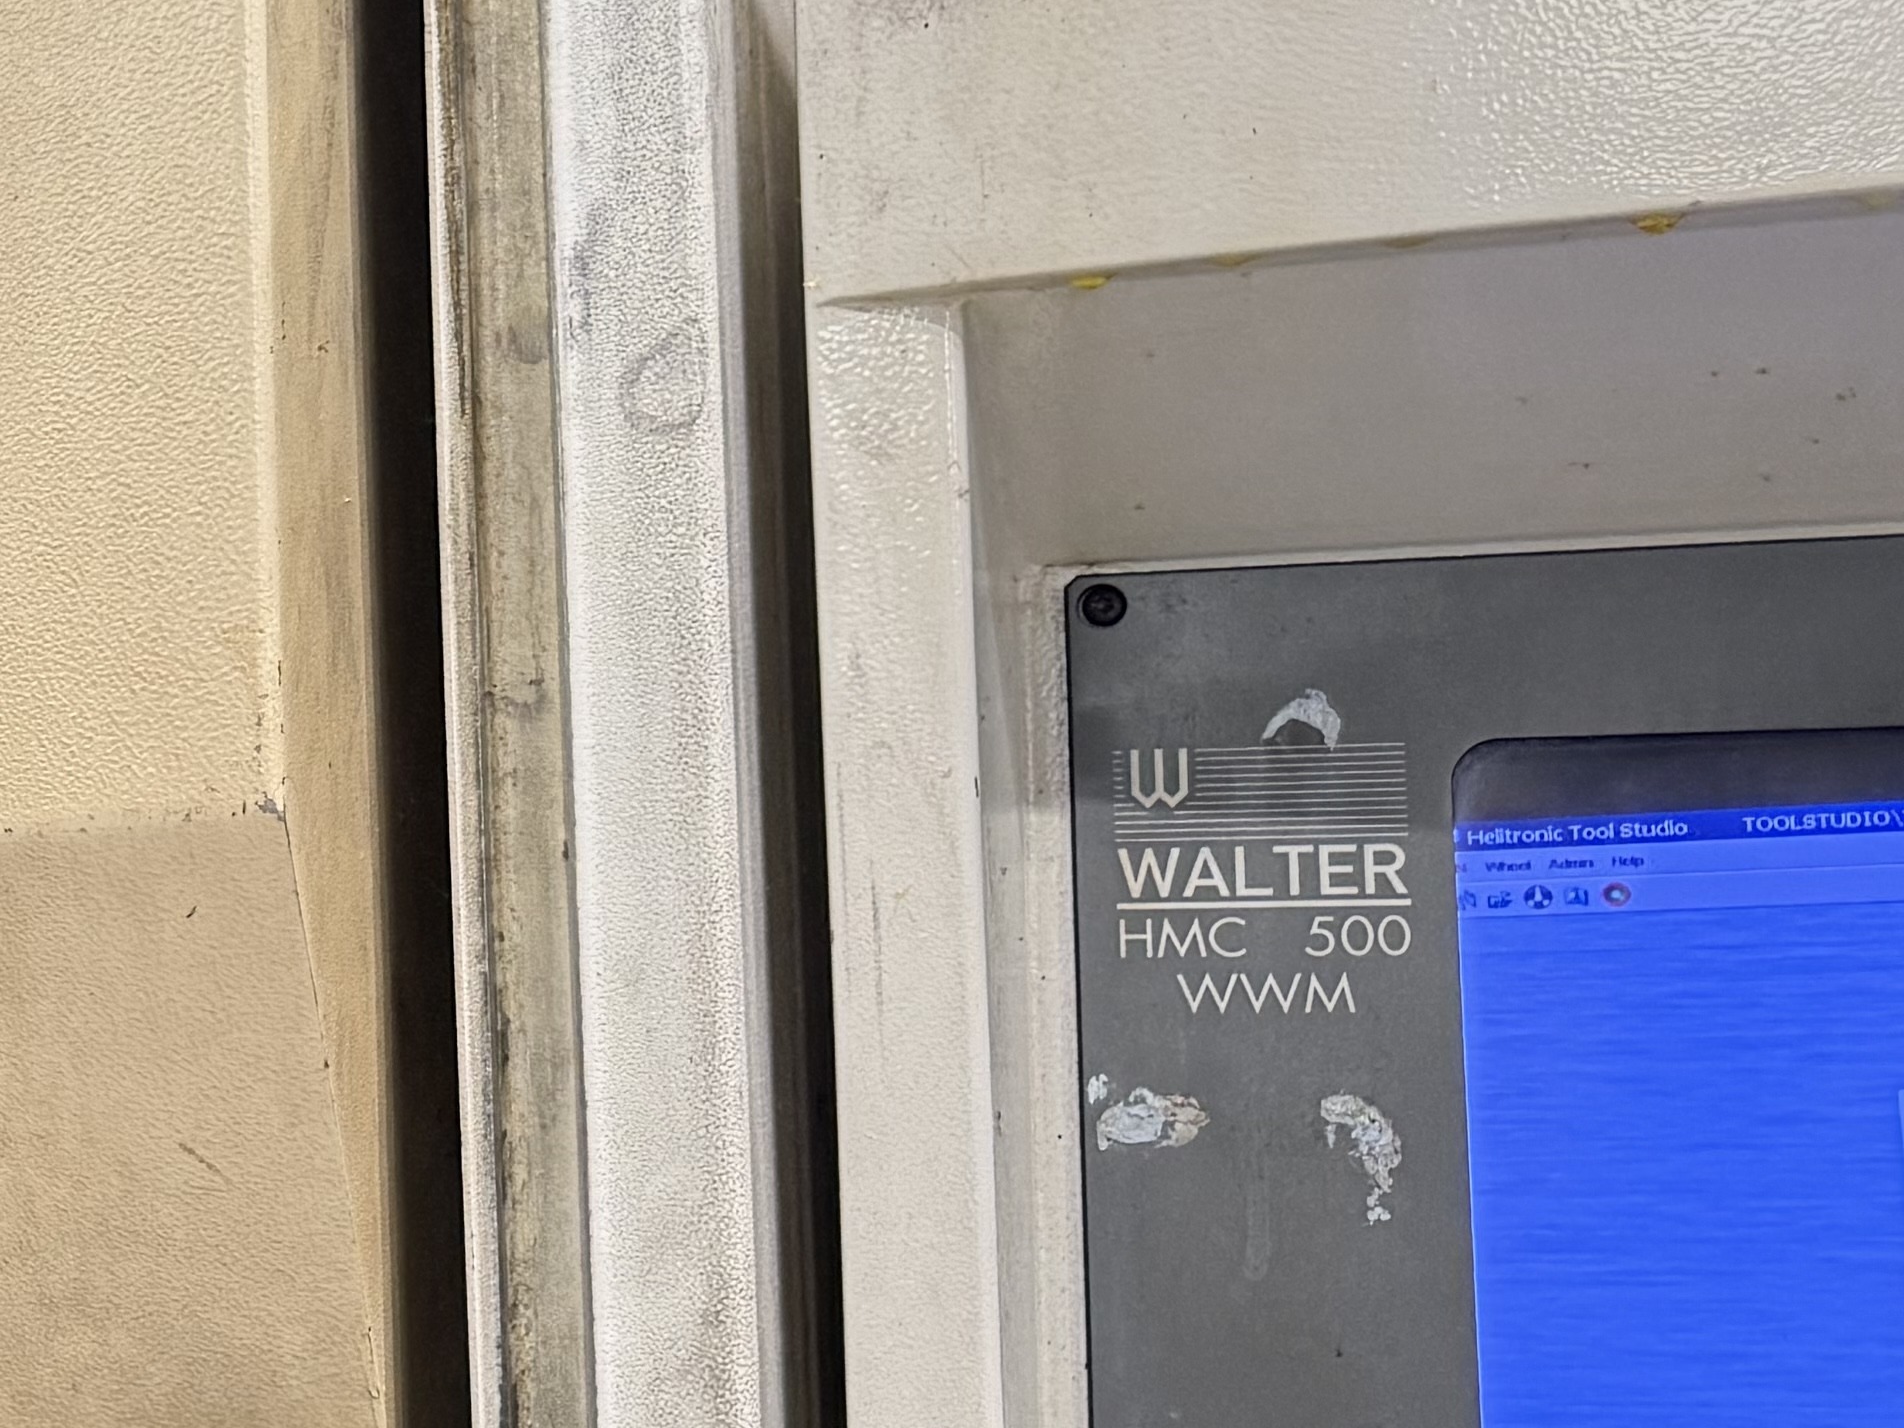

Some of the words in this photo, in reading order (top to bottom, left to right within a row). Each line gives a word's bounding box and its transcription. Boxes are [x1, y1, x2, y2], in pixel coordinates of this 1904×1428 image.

[1467, 825, 1563, 846] Helitronic
[1568, 822, 1615, 841] Tool
[1620, 819, 1688, 838] Studio
[1118, 842, 1407, 899] WALTER
[1612, 856, 1645, 869] Help
[1119, 918, 1248, 958] HMC
[1304, 914, 1411, 956] 500
[1177, 973, 1356, 1014] WWM
